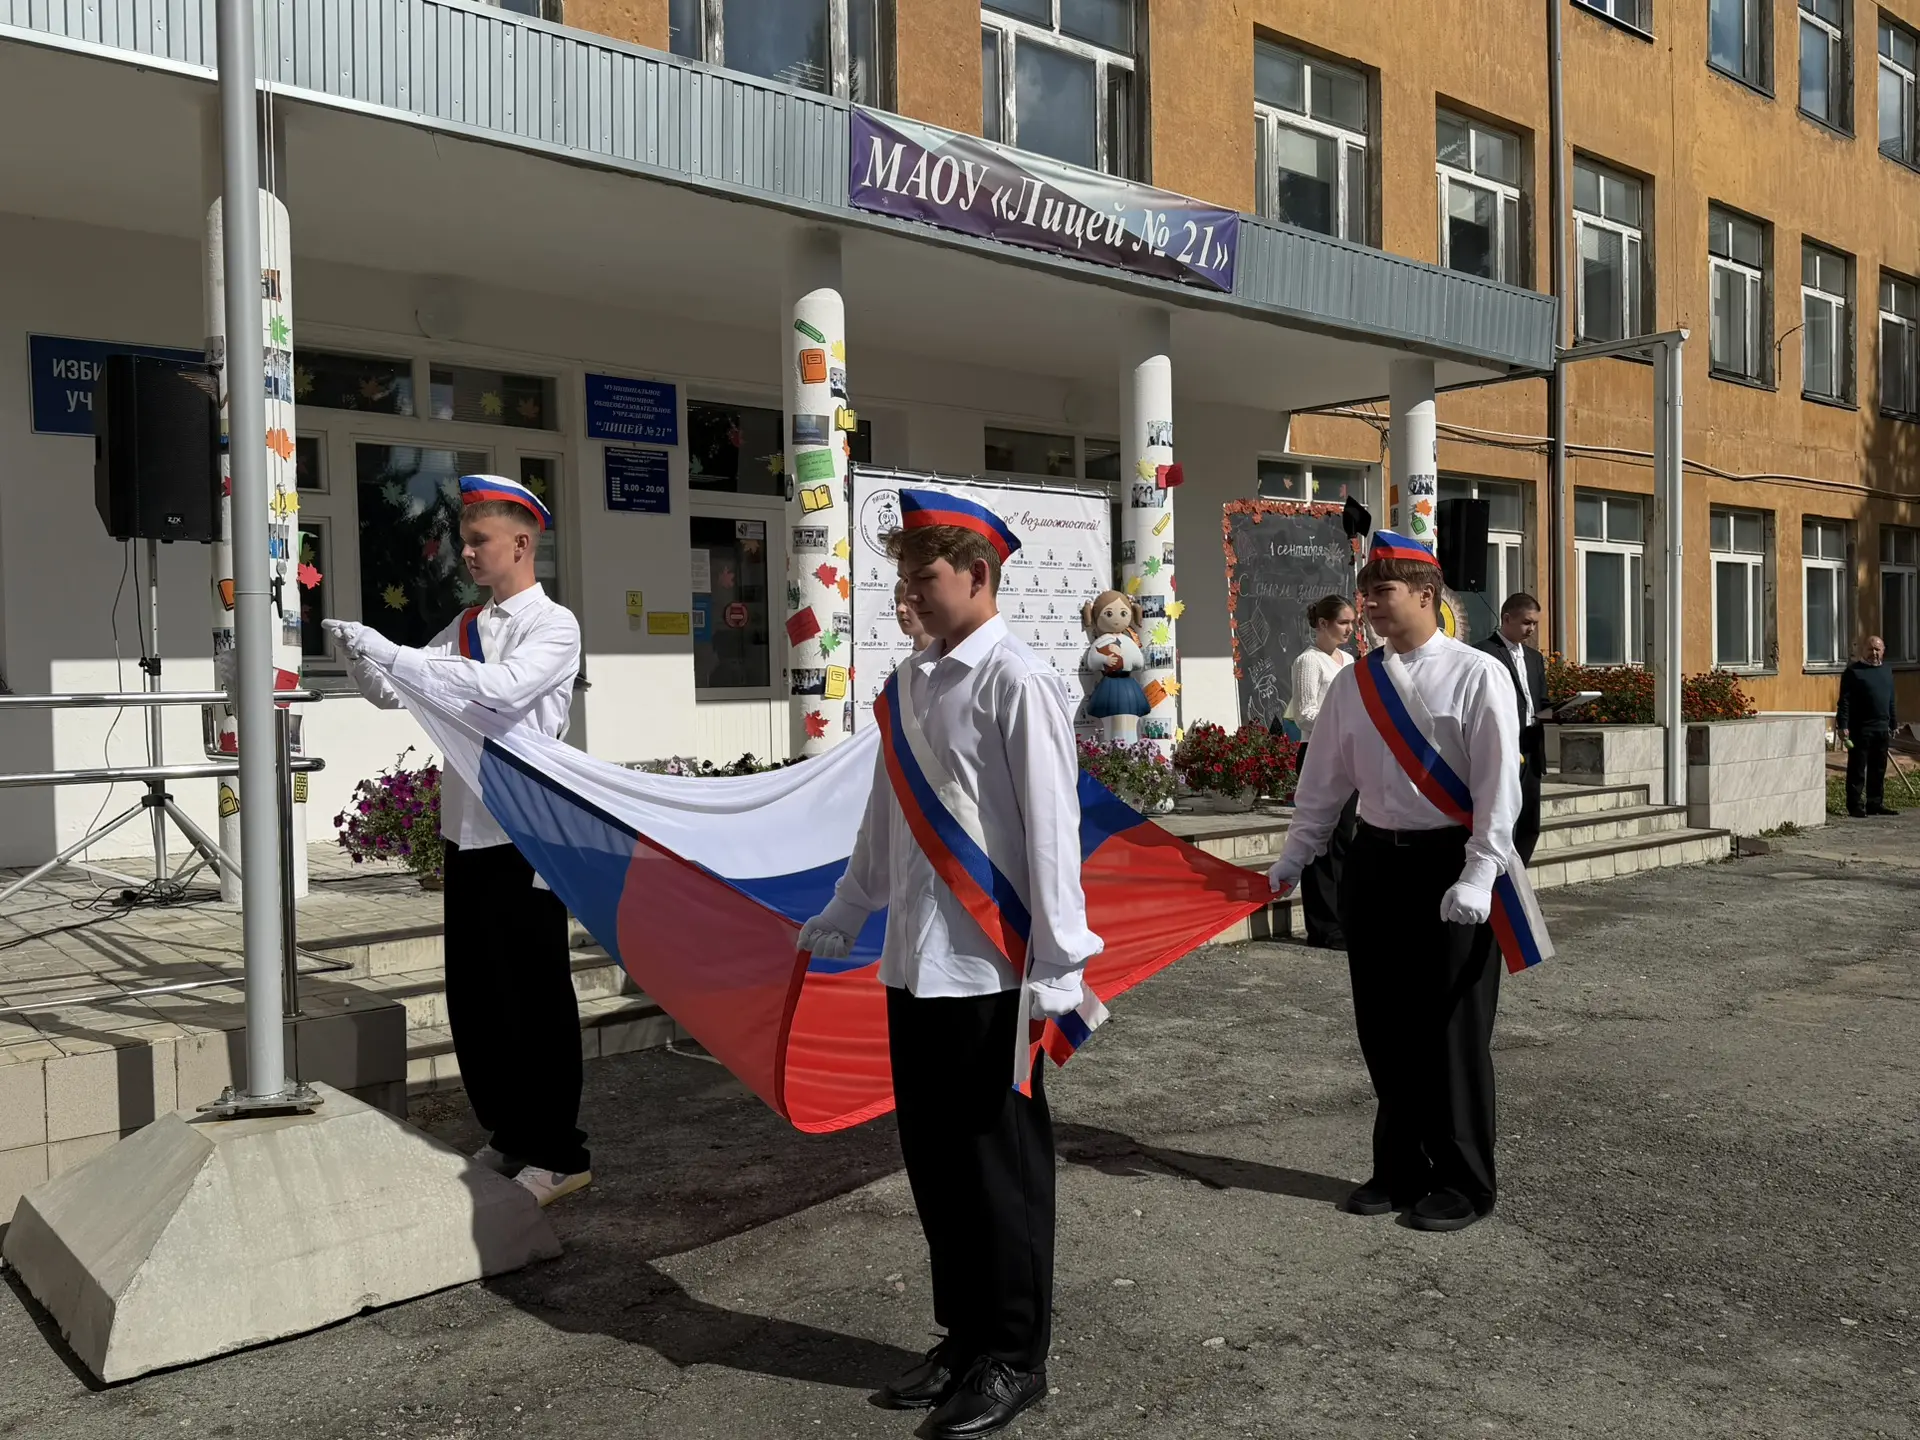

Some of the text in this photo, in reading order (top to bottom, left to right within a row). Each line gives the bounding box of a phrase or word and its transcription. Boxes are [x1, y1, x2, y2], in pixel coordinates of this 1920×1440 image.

[861, 136, 1229, 272] МАОУ «Лицей № 21»
[52, 358, 104, 382] ИЗБИ
[603, 384, 661, 397] МУНИЦИПАЛЬНОЕ
[66, 389, 93, 413] УЧ
[593, 400, 672, 414] ОБЩЕОБРАЗОВАТЕЛЬНОЕ
[612, 395, 655, 405] АВТОНОМНОЕ
[612, 410, 656, 420] УЧРЕЖДЕНИЕ
[644, 426, 655, 436] №
[624, 483, 640, 492] 8.00
[645, 485, 665, 494] 20.00
[1020, 510, 1101, 532] возможностей!
[1269, 535, 1325, 563] 1 сентября
